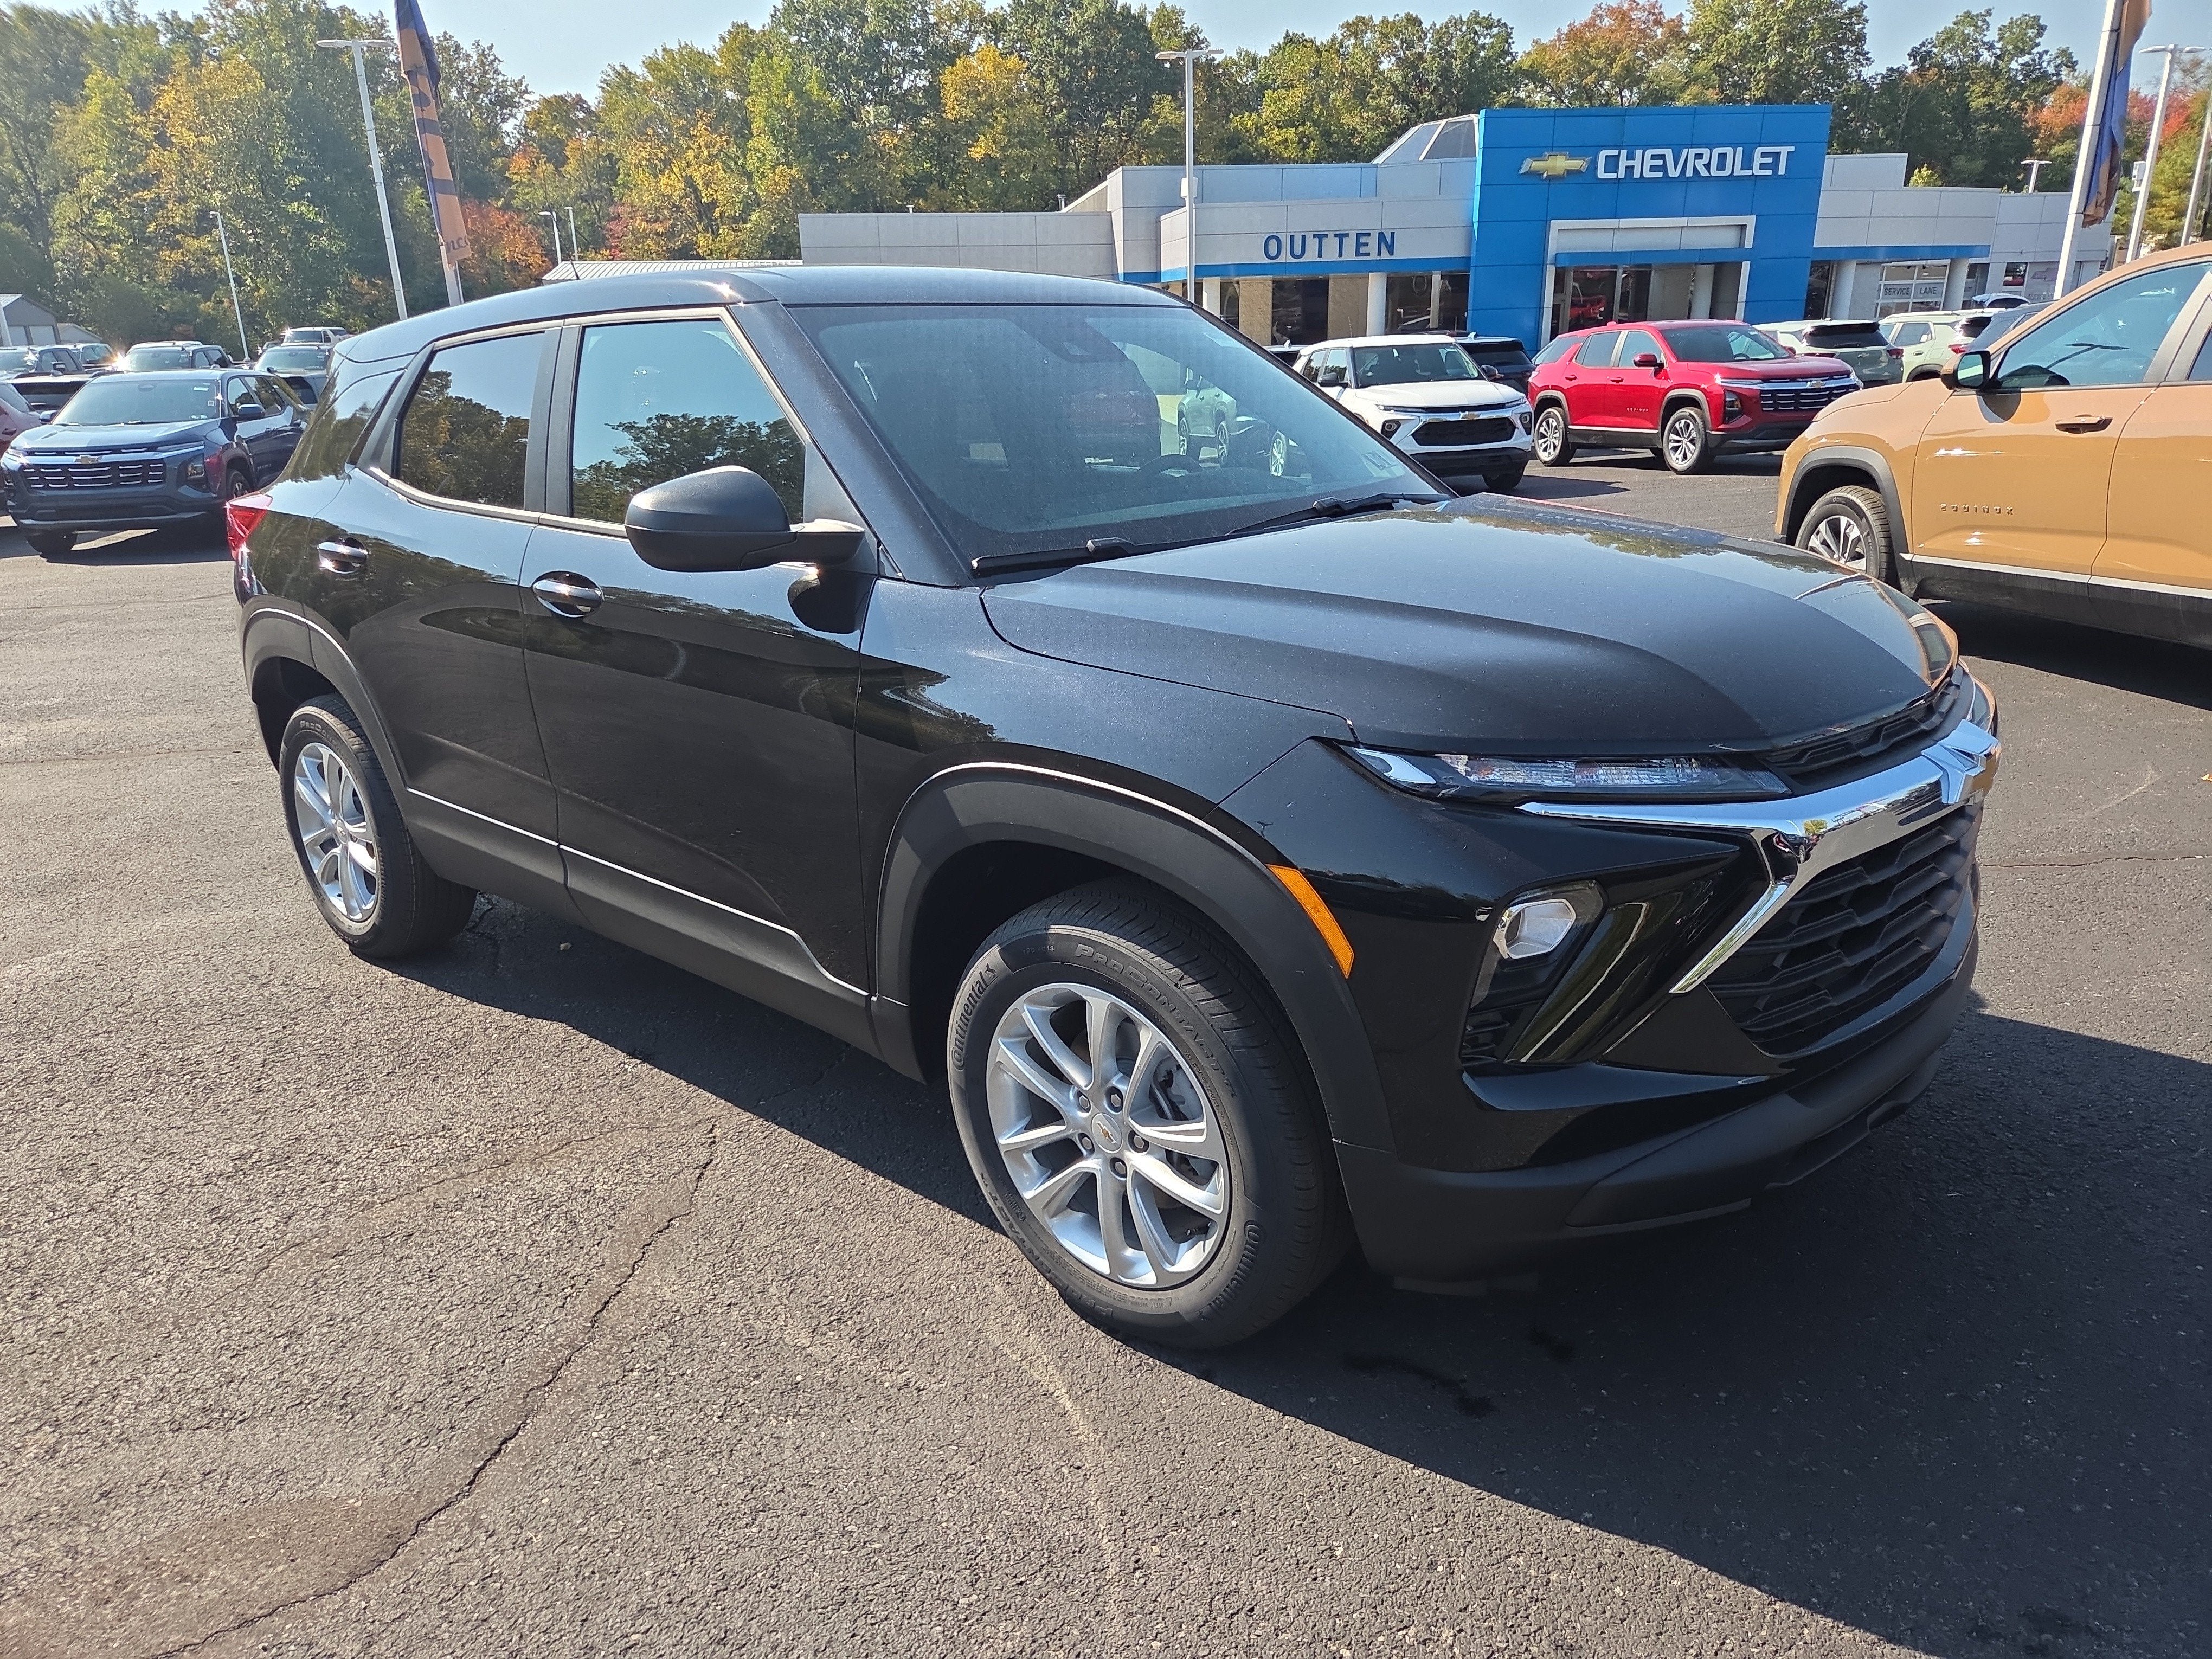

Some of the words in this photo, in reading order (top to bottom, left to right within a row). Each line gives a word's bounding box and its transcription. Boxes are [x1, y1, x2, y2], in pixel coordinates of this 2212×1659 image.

[1597, 146, 1795, 179] CHEVROLET
[1264, 232, 1395, 260] OUTTEN
[1884, 287, 1910, 295] SERVICE
